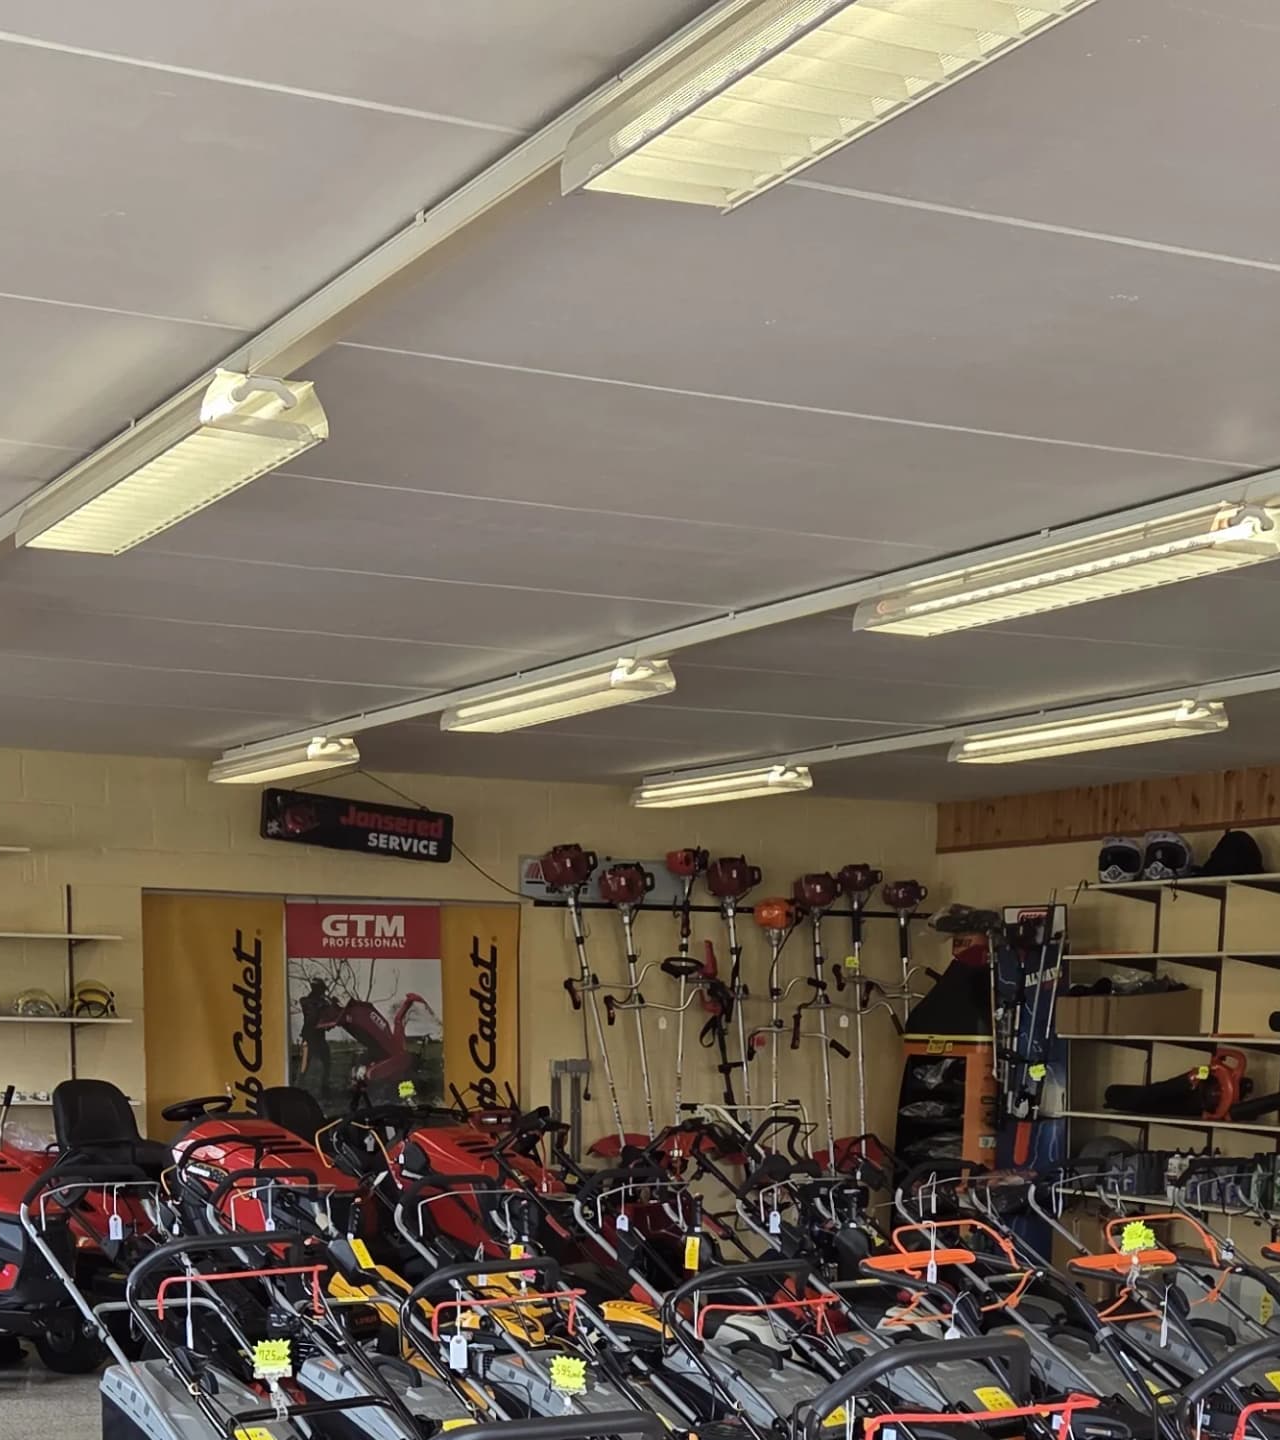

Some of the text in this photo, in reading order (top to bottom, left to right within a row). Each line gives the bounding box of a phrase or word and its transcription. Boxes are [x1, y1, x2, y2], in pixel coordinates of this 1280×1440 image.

[367, 832, 439, 856] SERVICE
[322, 914, 406, 938] GTM
[322, 937, 407, 949] PROFESSIONAL
[469, 935, 499, 1075] Cadet
[233, 928, 265, 1115] ub Cadet
